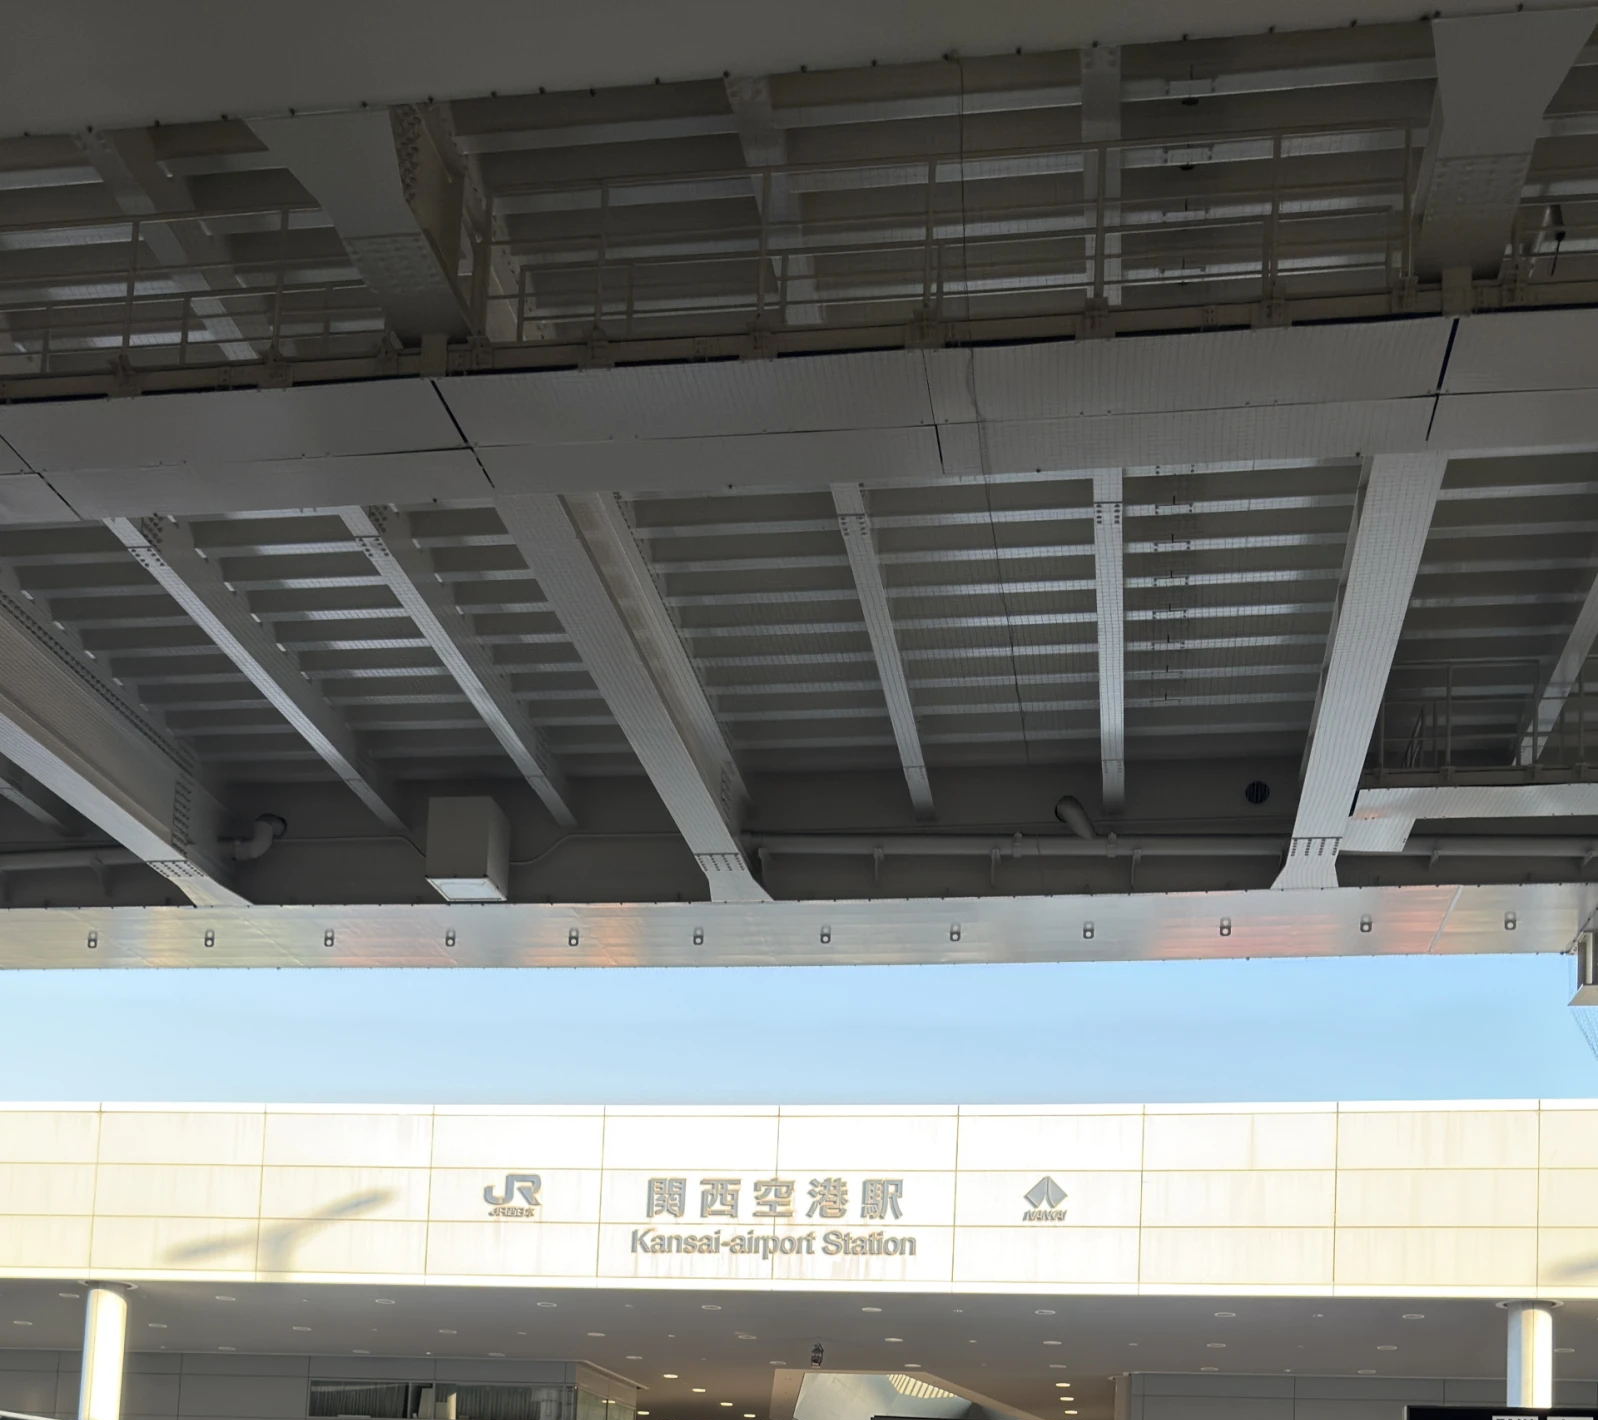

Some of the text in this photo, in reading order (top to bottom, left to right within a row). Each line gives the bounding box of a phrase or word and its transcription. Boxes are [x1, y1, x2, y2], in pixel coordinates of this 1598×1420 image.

[483, 1174, 541, 1206] JR
[646, 1177, 904, 1220] 関西空港駅
[1022, 1209, 1068, 1222] NANKAI
[631, 1229, 918, 1260] Kansai-airport Station
